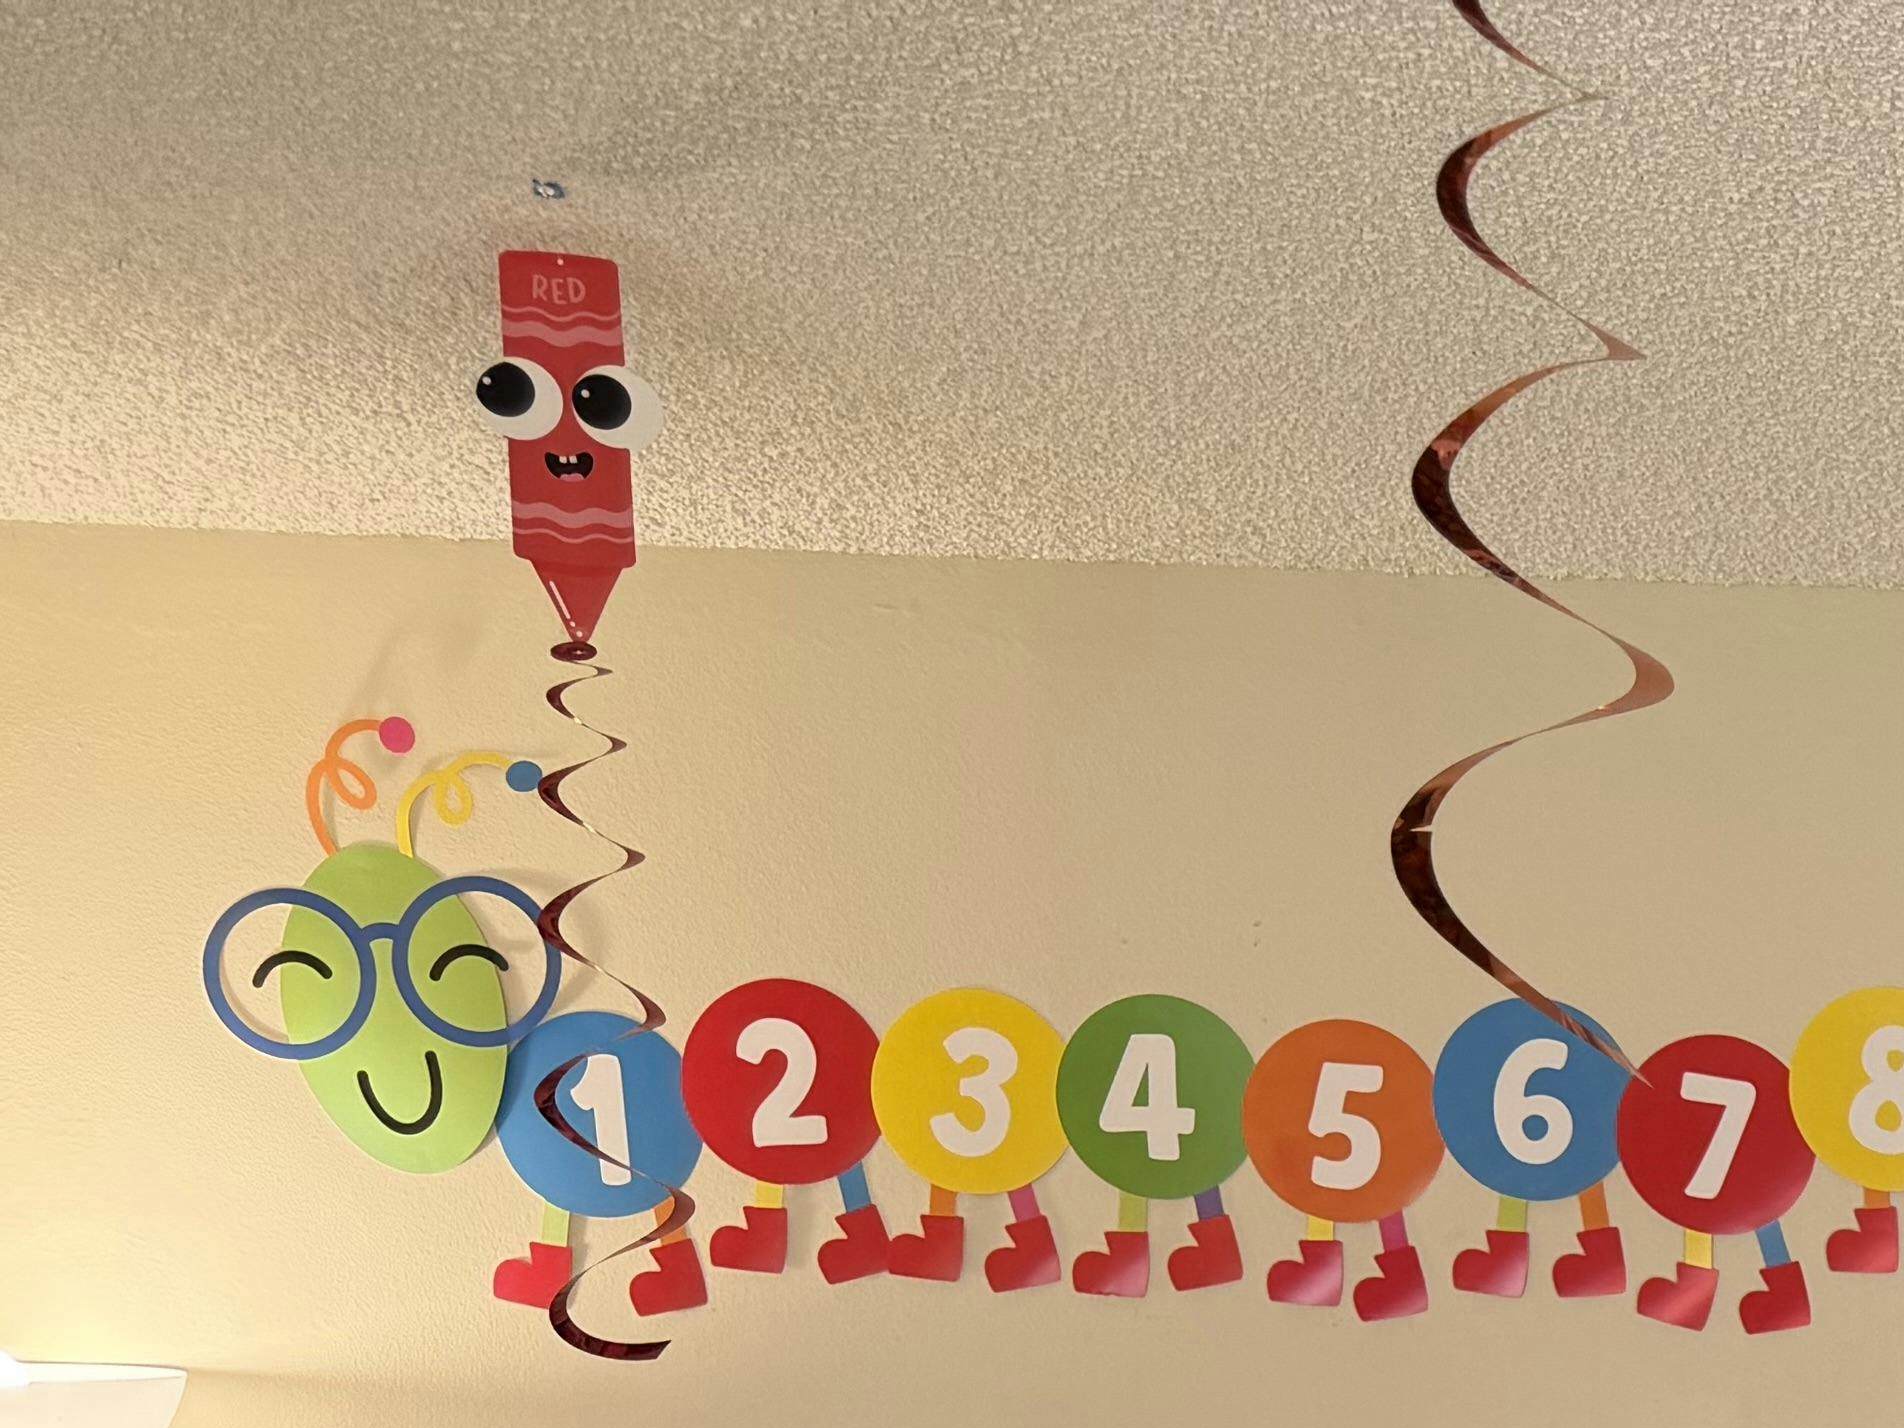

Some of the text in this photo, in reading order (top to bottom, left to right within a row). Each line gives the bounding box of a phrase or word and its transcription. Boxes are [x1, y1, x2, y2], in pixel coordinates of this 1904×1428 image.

[531, 274, 587, 306] RED
[568, 1053, 632, 1186] 1
[735, 1018, 828, 1147] 2
[929, 1027, 1019, 1158] 3
[1099, 1032, 1196, 1161] 4
[1309, 1061, 1384, 1190] 5
[1493, 1037, 1574, 1165] 6
[1679, 1072, 1756, 1200] 7
